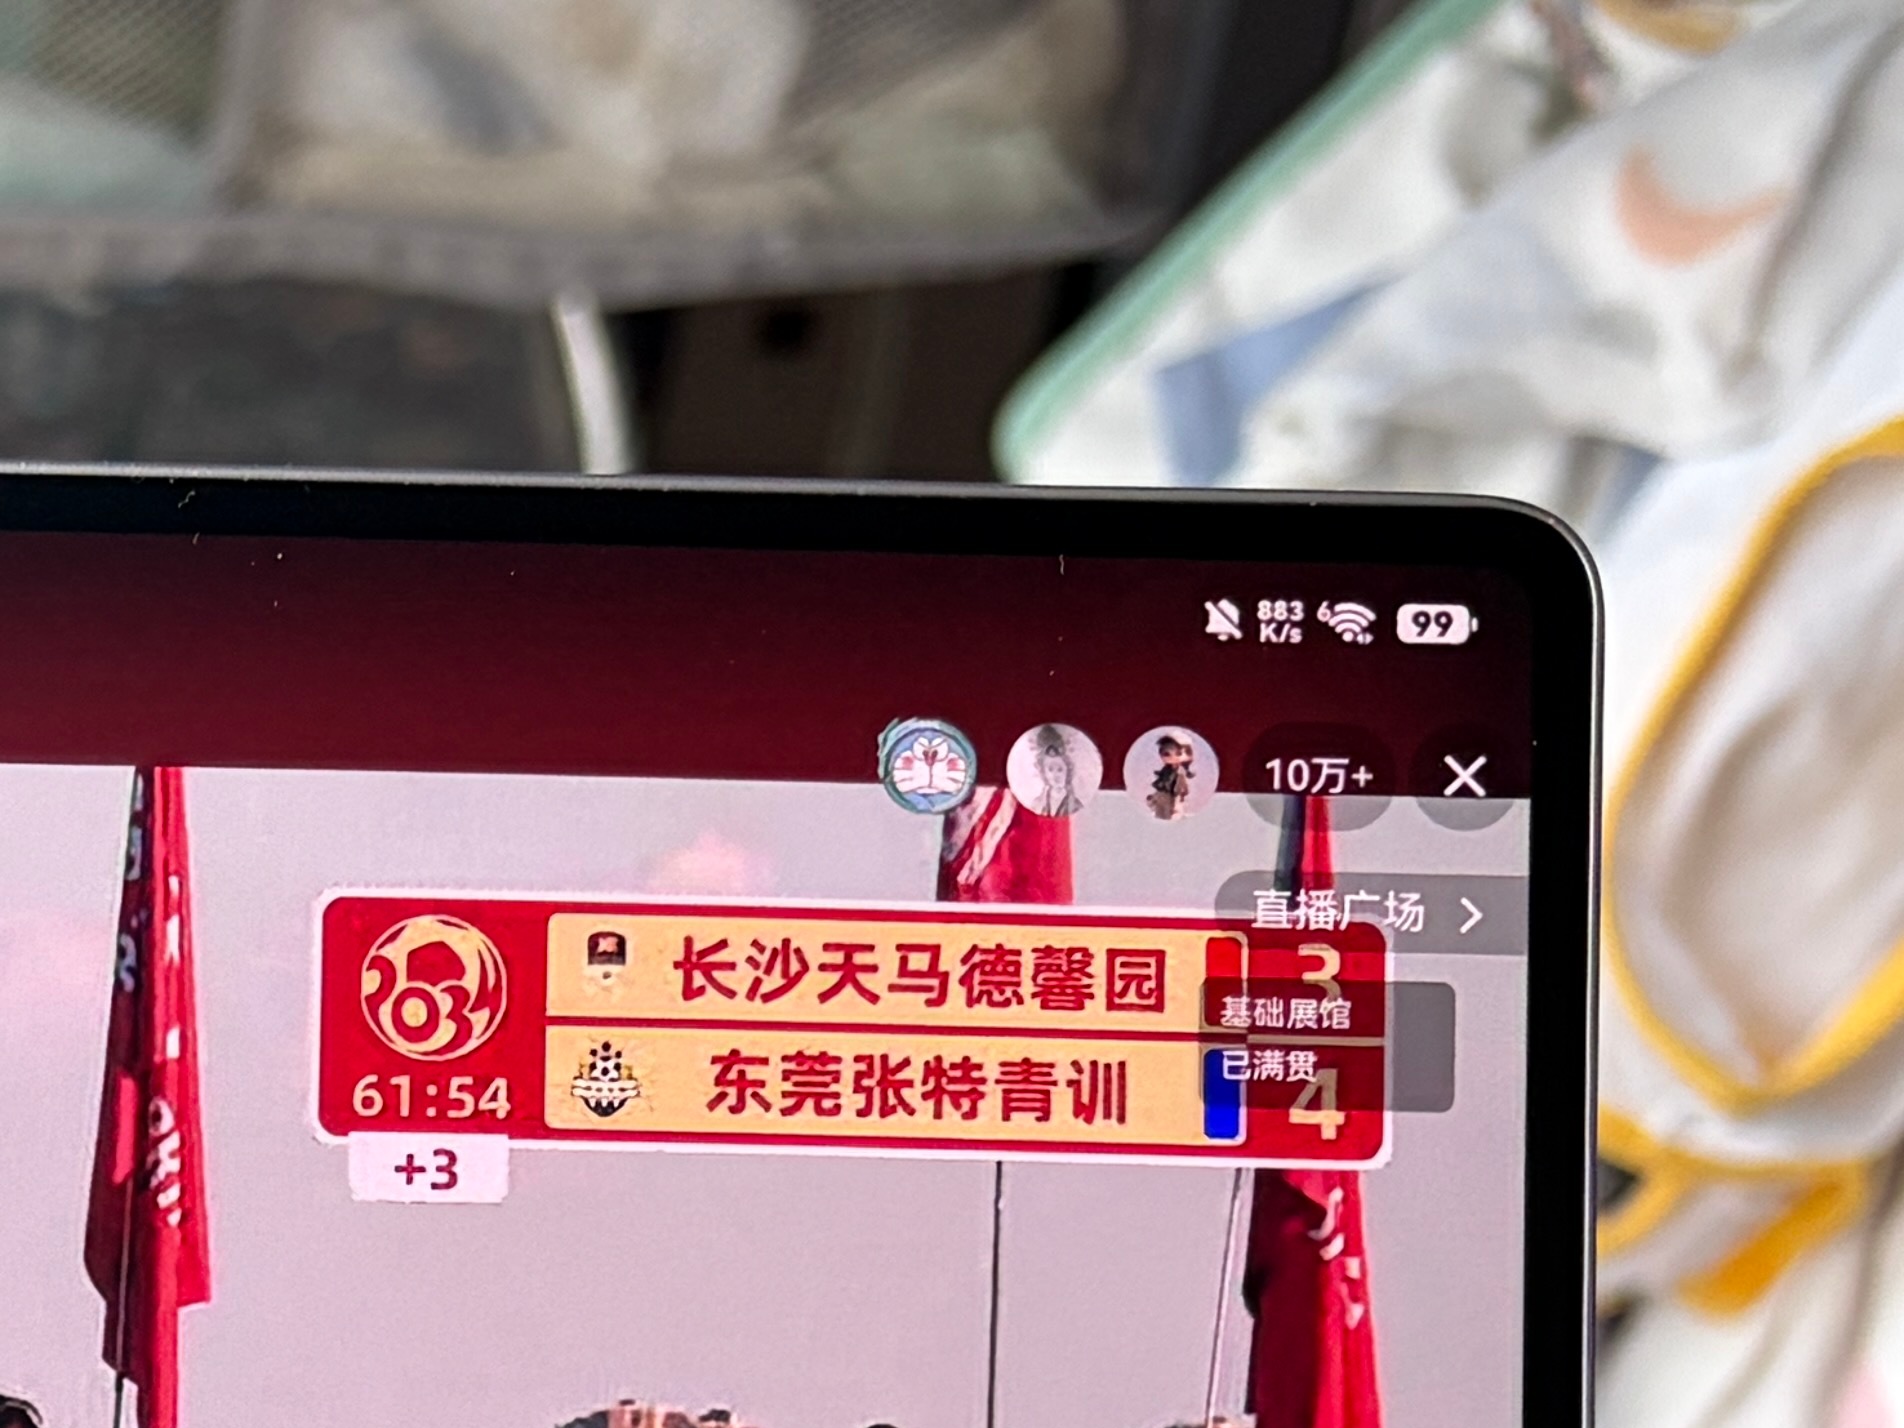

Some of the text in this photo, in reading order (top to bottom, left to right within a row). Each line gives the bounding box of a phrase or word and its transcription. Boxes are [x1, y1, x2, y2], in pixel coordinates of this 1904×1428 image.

[1257, 600, 1304, 621] 883
[1411, 610, 1454, 637] 99
[1259, 623, 1303, 643] K/s
[1266, 757, 1374, 795] 10万+
[1252, 890, 1426, 933] 直播广场
[673, 936, 1167, 1014] 长沙天马德馨园
[1219, 996, 1352, 1033] 基础展馆
[1221, 1049, 1317, 1084] 已满贯
[352, 1074, 512, 1120] 61:54
[706, 1047, 1129, 1125] 东莞张特青训
[394, 1148, 459, 1191] +3
